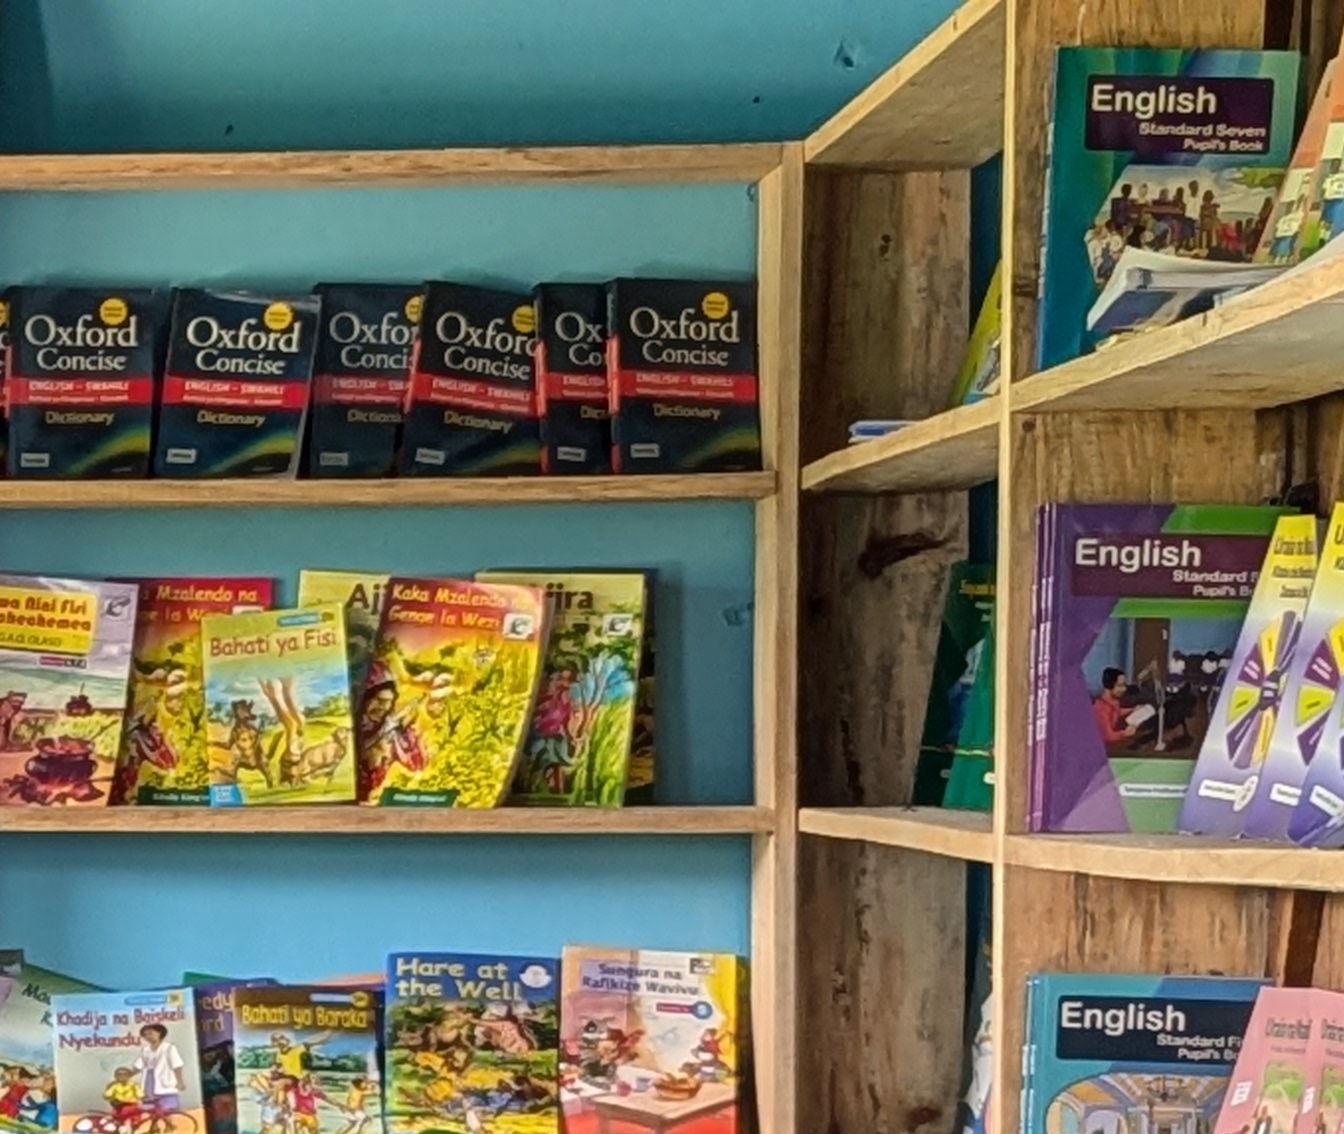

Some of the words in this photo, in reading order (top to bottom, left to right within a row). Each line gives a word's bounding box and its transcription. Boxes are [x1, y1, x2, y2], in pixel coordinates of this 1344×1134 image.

[1091, 83, 1217, 119] English
[1139, 123, 1212, 137] Standard
[1216, 125, 1266, 138] Seven
[1183, 138, 1226, 152] Pupil's
[1230, 139, 1264, 151] Book
[24, 314, 139, 347] Oxford
[186, 316, 302, 353] Oxford
[630, 305, 740, 344] Oxford
[37, 347, 127, 371] Concise
[195, 349, 286, 375] Concise
[340, 345, 412, 370] Conci
[642, 339, 728, 366] Concise
[444, 350, 530, 381] Concise
[45, 410, 115, 427] Dictionary
[197, 410, 266, 428] Dictionary
[444, 409, 512, 434] Dictionary
[653, 404, 721, 422] Dictionary
[1075, 537, 1201, 573] English
[1173, 569, 1248, 584] Standard
[156, 585, 232, 602] Mzalendo
[238, 589, 257, 601] na
[392, 584, 430, 601] Kaka
[435, 586, 506, 607] Mzalendo
[61, 600, 87, 615] Fisi
[441, 610, 456, 626] la
[210, 635, 270, 657] Bahati
[276, 635, 298, 657] ya
[304, 627, 337, 650] Fisi
[396, 957, 465, 977] Hare
[477, 962, 508, 980] at
[598, 963, 660, 981] Sungura
[664, 968, 682, 980] na
[396, 979, 442, 997] the
[456, 980, 523, 1000] Well
[582, 976, 641, 993] Rafikize
[646, 980, 700, 996] Wavivu
[202, 992, 234, 1013] edy
[56, 1010, 107, 1027] Khadija
[113, 1012, 129, 1025] na
[134, 1007, 185, 1025] Baiskeli
[242, 1006, 288, 1024] Bahati
[293, 1008, 312, 1028] ya
[317, 1007, 369, 1028] Baraka
[1060, 1000, 1186, 1036] English
[59, 1034, 141, 1051] Nyekundu
[1156, 1033, 1225, 1048] Standard
